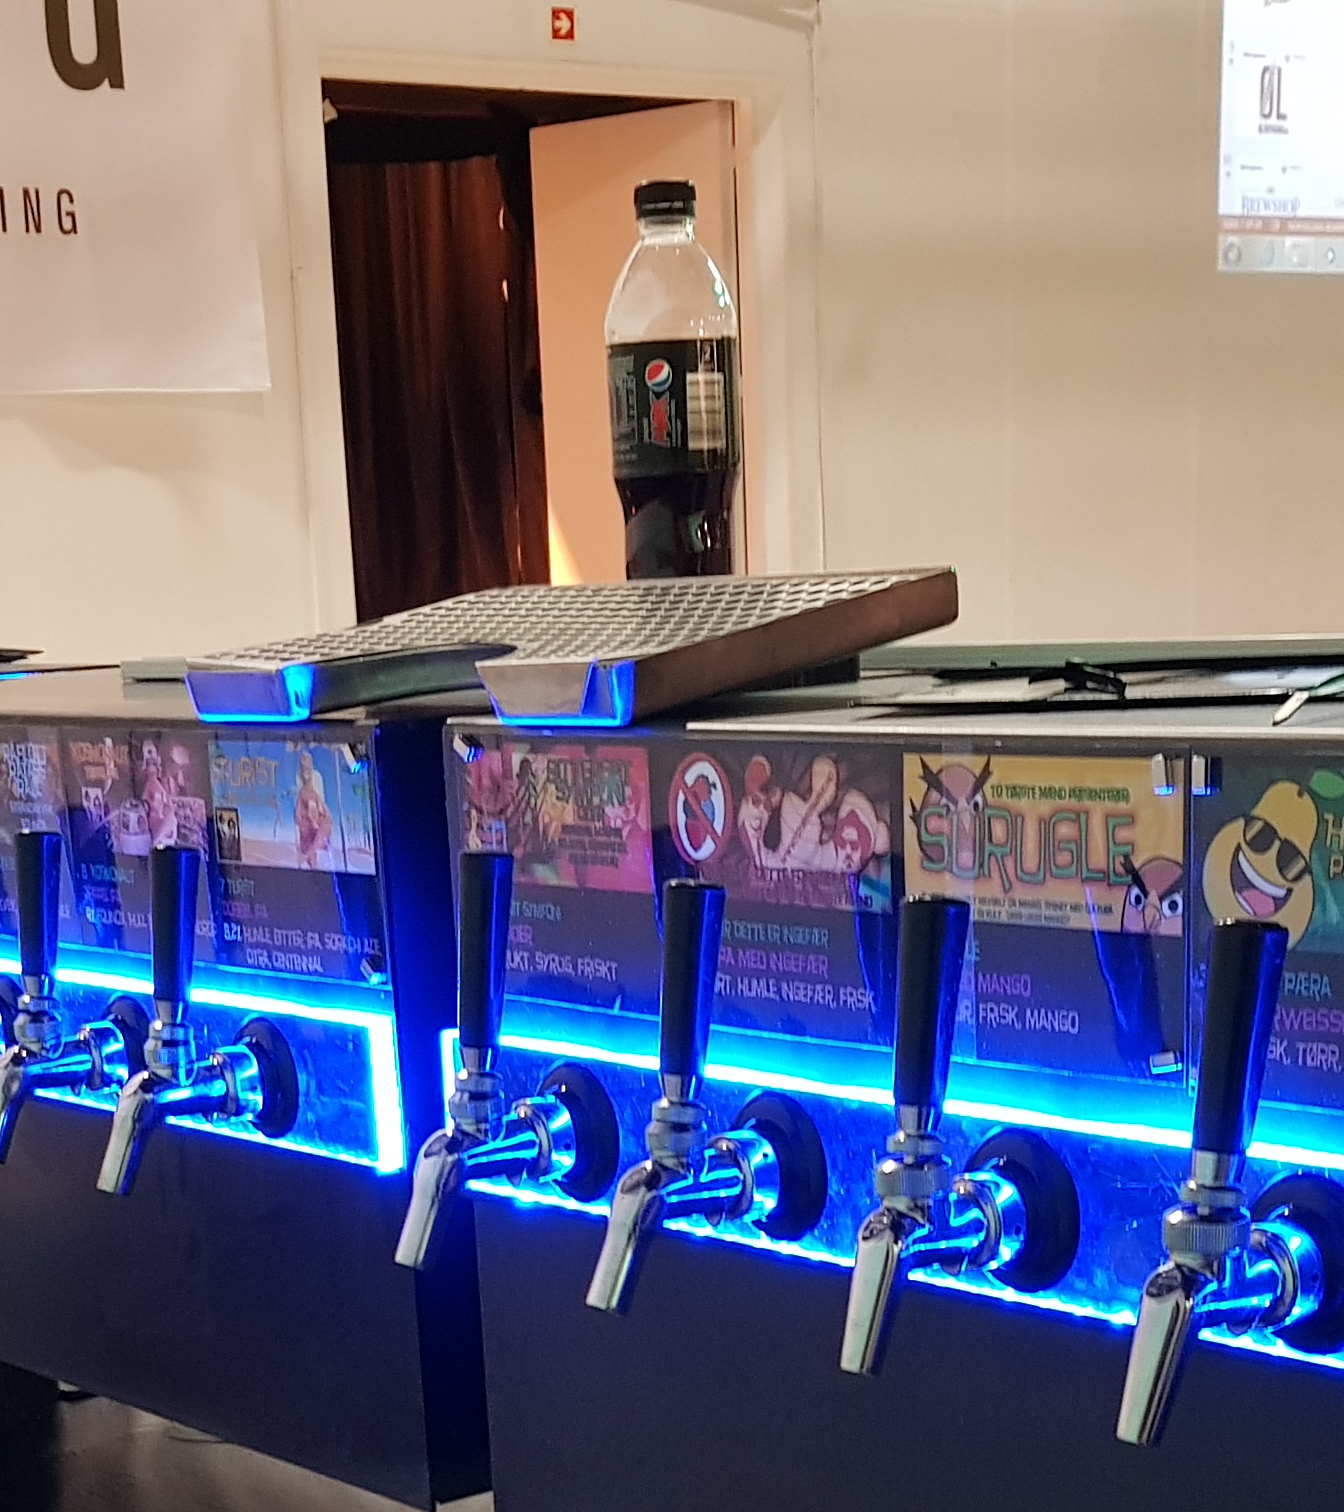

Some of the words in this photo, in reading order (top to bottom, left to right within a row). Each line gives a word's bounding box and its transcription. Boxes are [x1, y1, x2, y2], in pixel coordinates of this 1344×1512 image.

[920, 803, 1135, 894] SURUGLE
[506, 949, 534, 973] UKT,
[715, 971, 736, 998] RT,
[977, 971, 1032, 998] MANGO
[1024, 1007, 1080, 1035] MANGO
